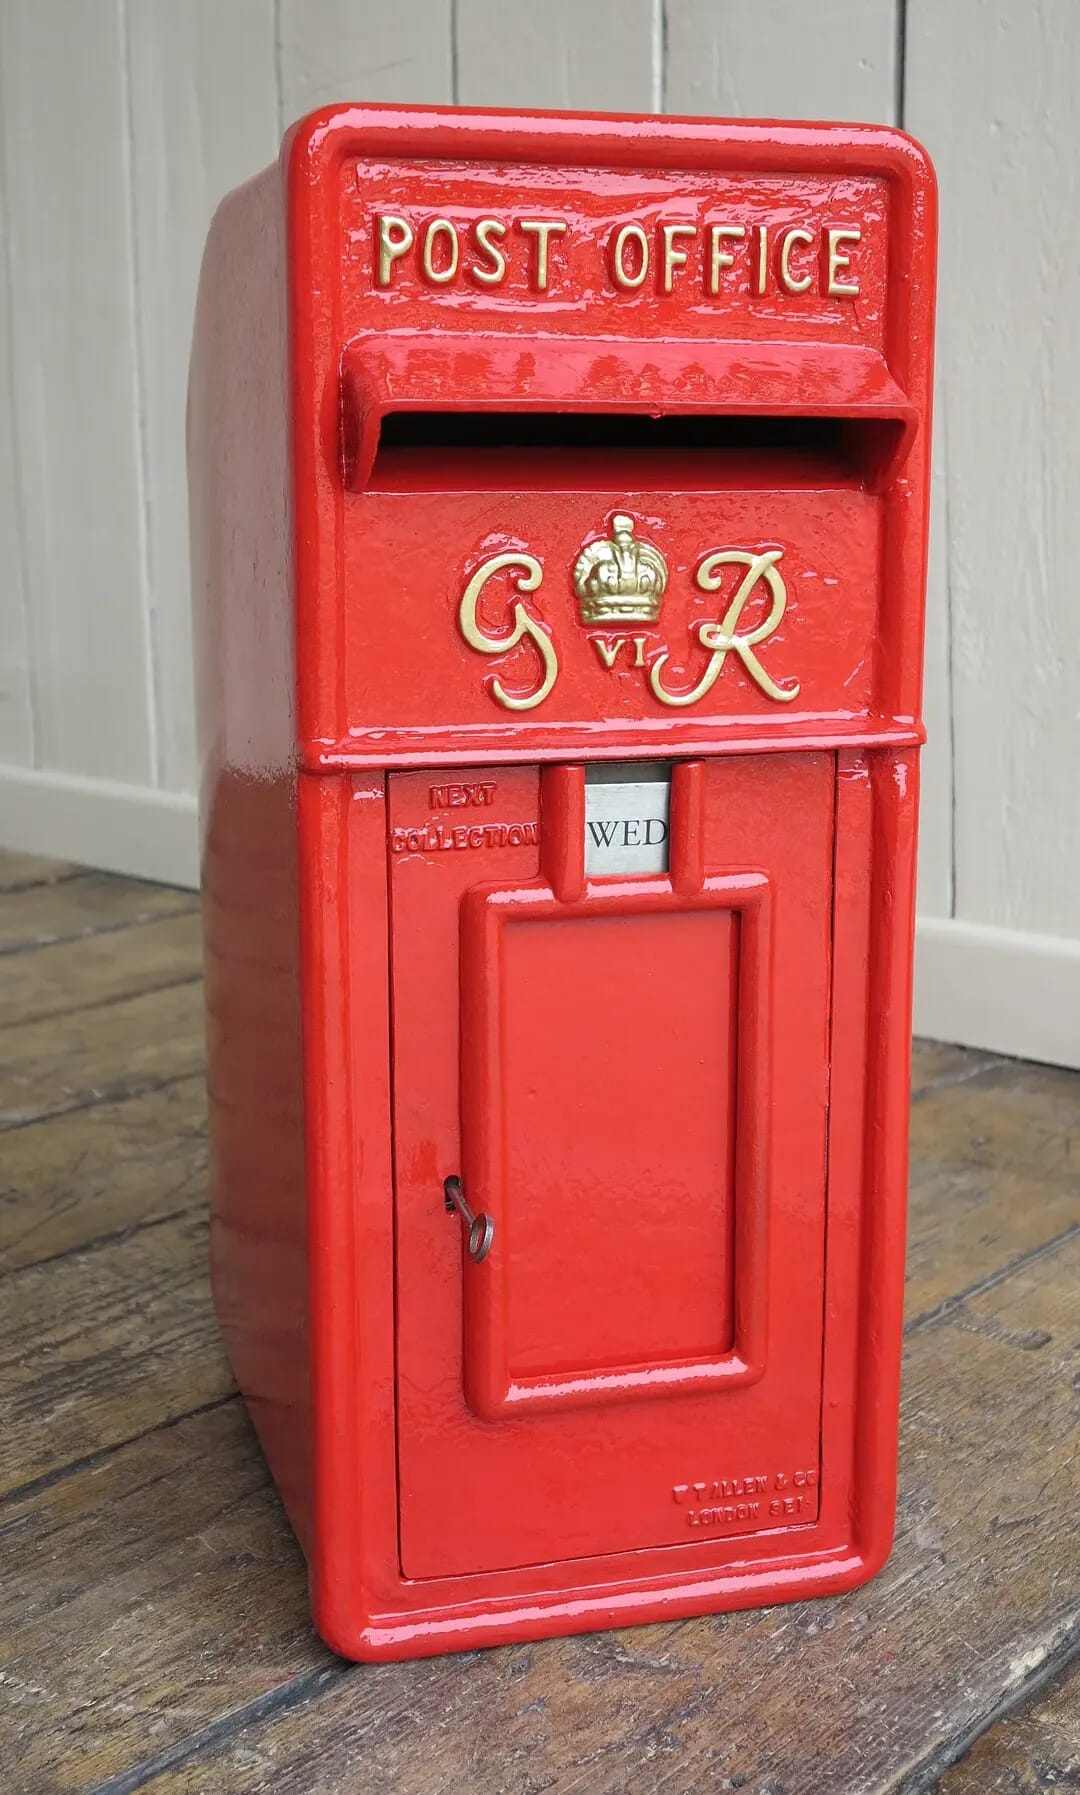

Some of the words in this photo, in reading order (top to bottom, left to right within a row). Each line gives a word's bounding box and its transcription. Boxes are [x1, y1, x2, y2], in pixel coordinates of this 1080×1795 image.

[379, 215, 566, 289] POST
[610, 223, 862, 296] OFFICE
[459, 553, 559, 711] G
[595, 638, 646, 667] VI
[650, 550, 801, 706] R
[428, 781, 498, 809] NEXT
[391, 821, 539, 853] COLLECTION
[587, 819, 668, 848] WED
[709, 1476, 768, 1500] ALLEN
[774, 1473, 788, 1491] &
[688, 1502, 760, 1527] LONDON
